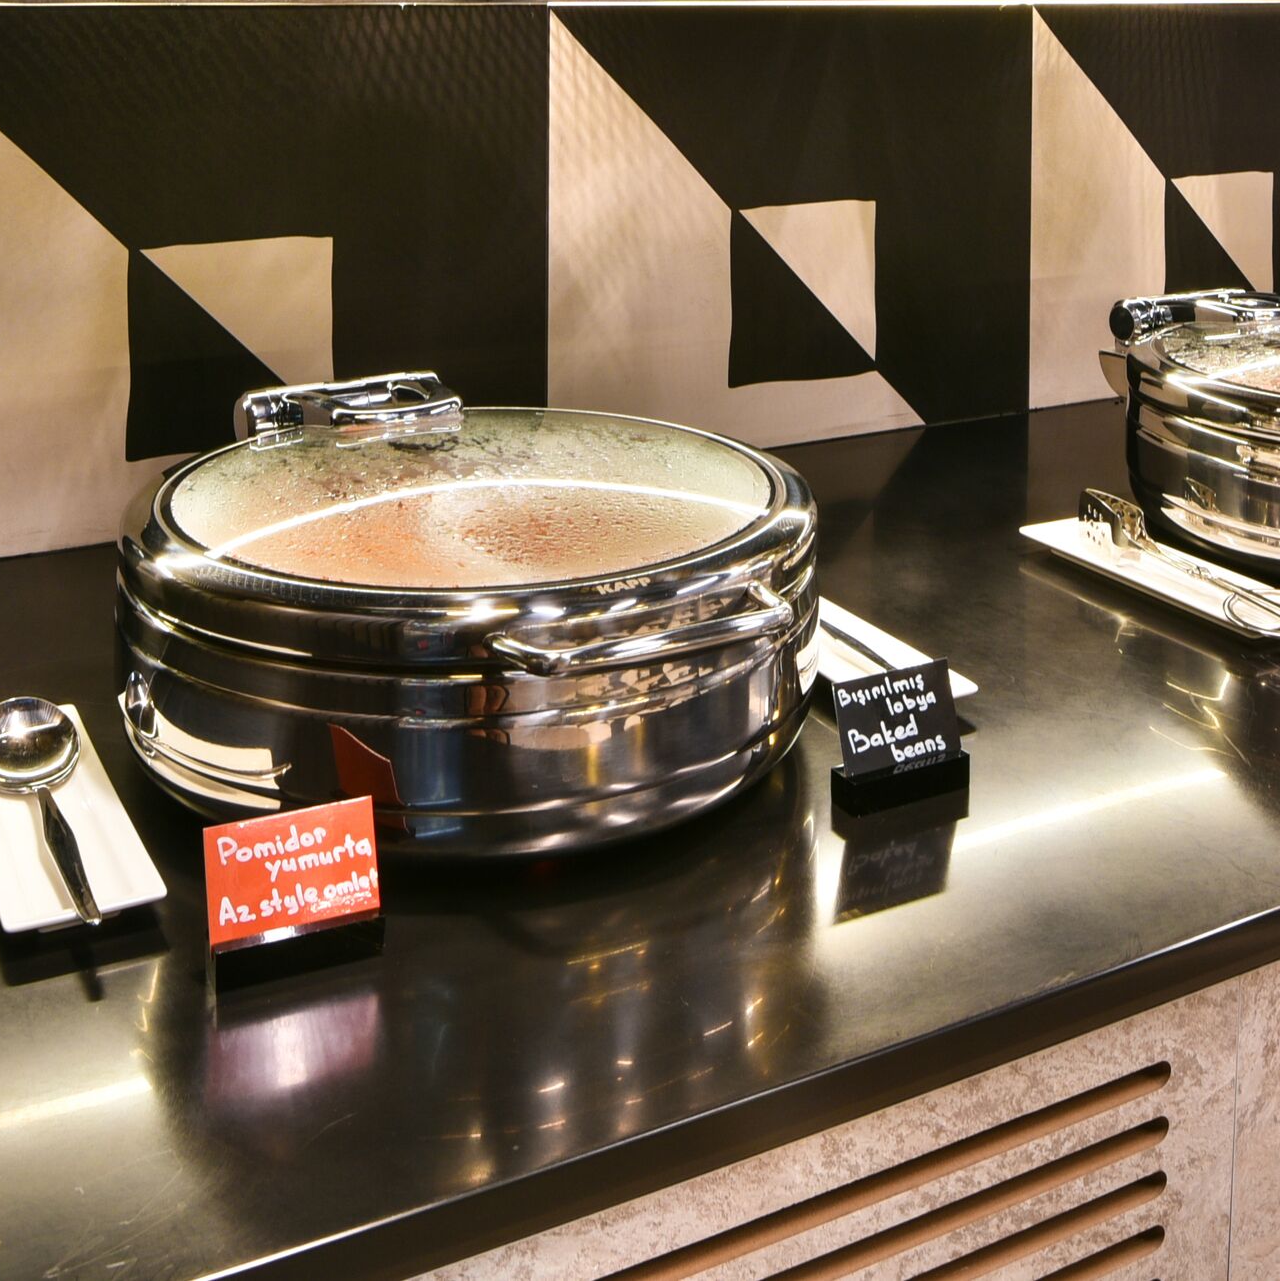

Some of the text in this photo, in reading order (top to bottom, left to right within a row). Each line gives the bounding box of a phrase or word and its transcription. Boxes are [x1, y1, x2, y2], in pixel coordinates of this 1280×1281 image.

[596, 577, 651, 595] KAPP
[886, 691, 936, 715] lobya
[847, 714, 918, 754] Baked
[890, 735, 946, 762] beans
[217, 824, 327, 866] Pomidor
[264, 833, 372, 882] yumurta
[259, 883, 318, 918] style
